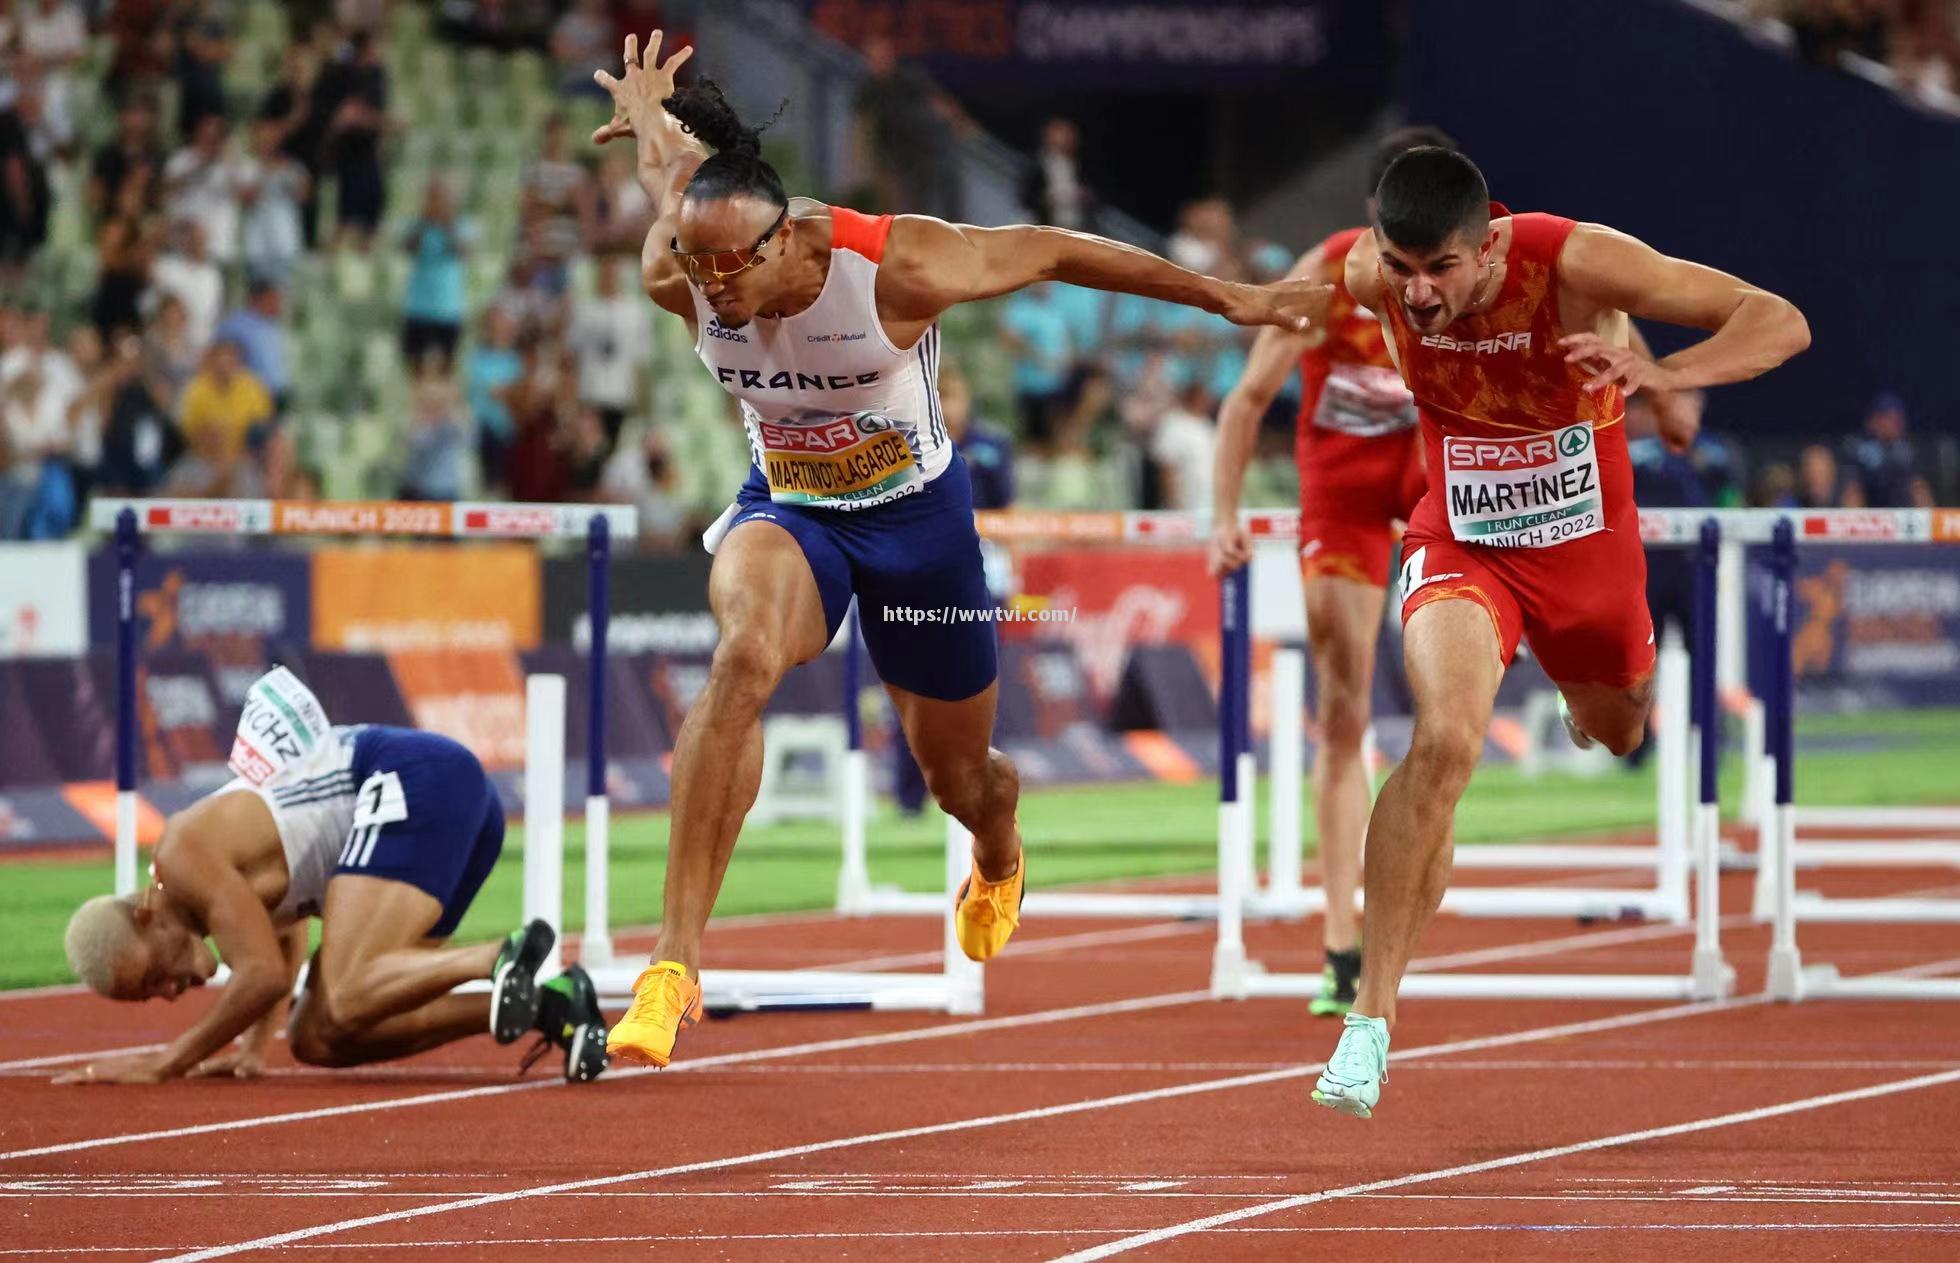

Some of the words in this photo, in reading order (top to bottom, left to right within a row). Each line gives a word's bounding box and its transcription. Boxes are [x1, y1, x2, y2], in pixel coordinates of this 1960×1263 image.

[707, 326, 748, 344] adidas
[1420, 332, 1532, 355] ESPAÑA
[717, 367, 880, 390] FRANCE
[763, 423, 855, 449] SPAR
[770, 436, 908, 490] MARTINOT-LAGARDE
[1451, 441, 1554, 467] SPAR
[1452, 463, 1595, 516] MARTÍNEZ
[1495, 518, 1522, 531] RUN
[1551, 514, 1594, 541] 2022
